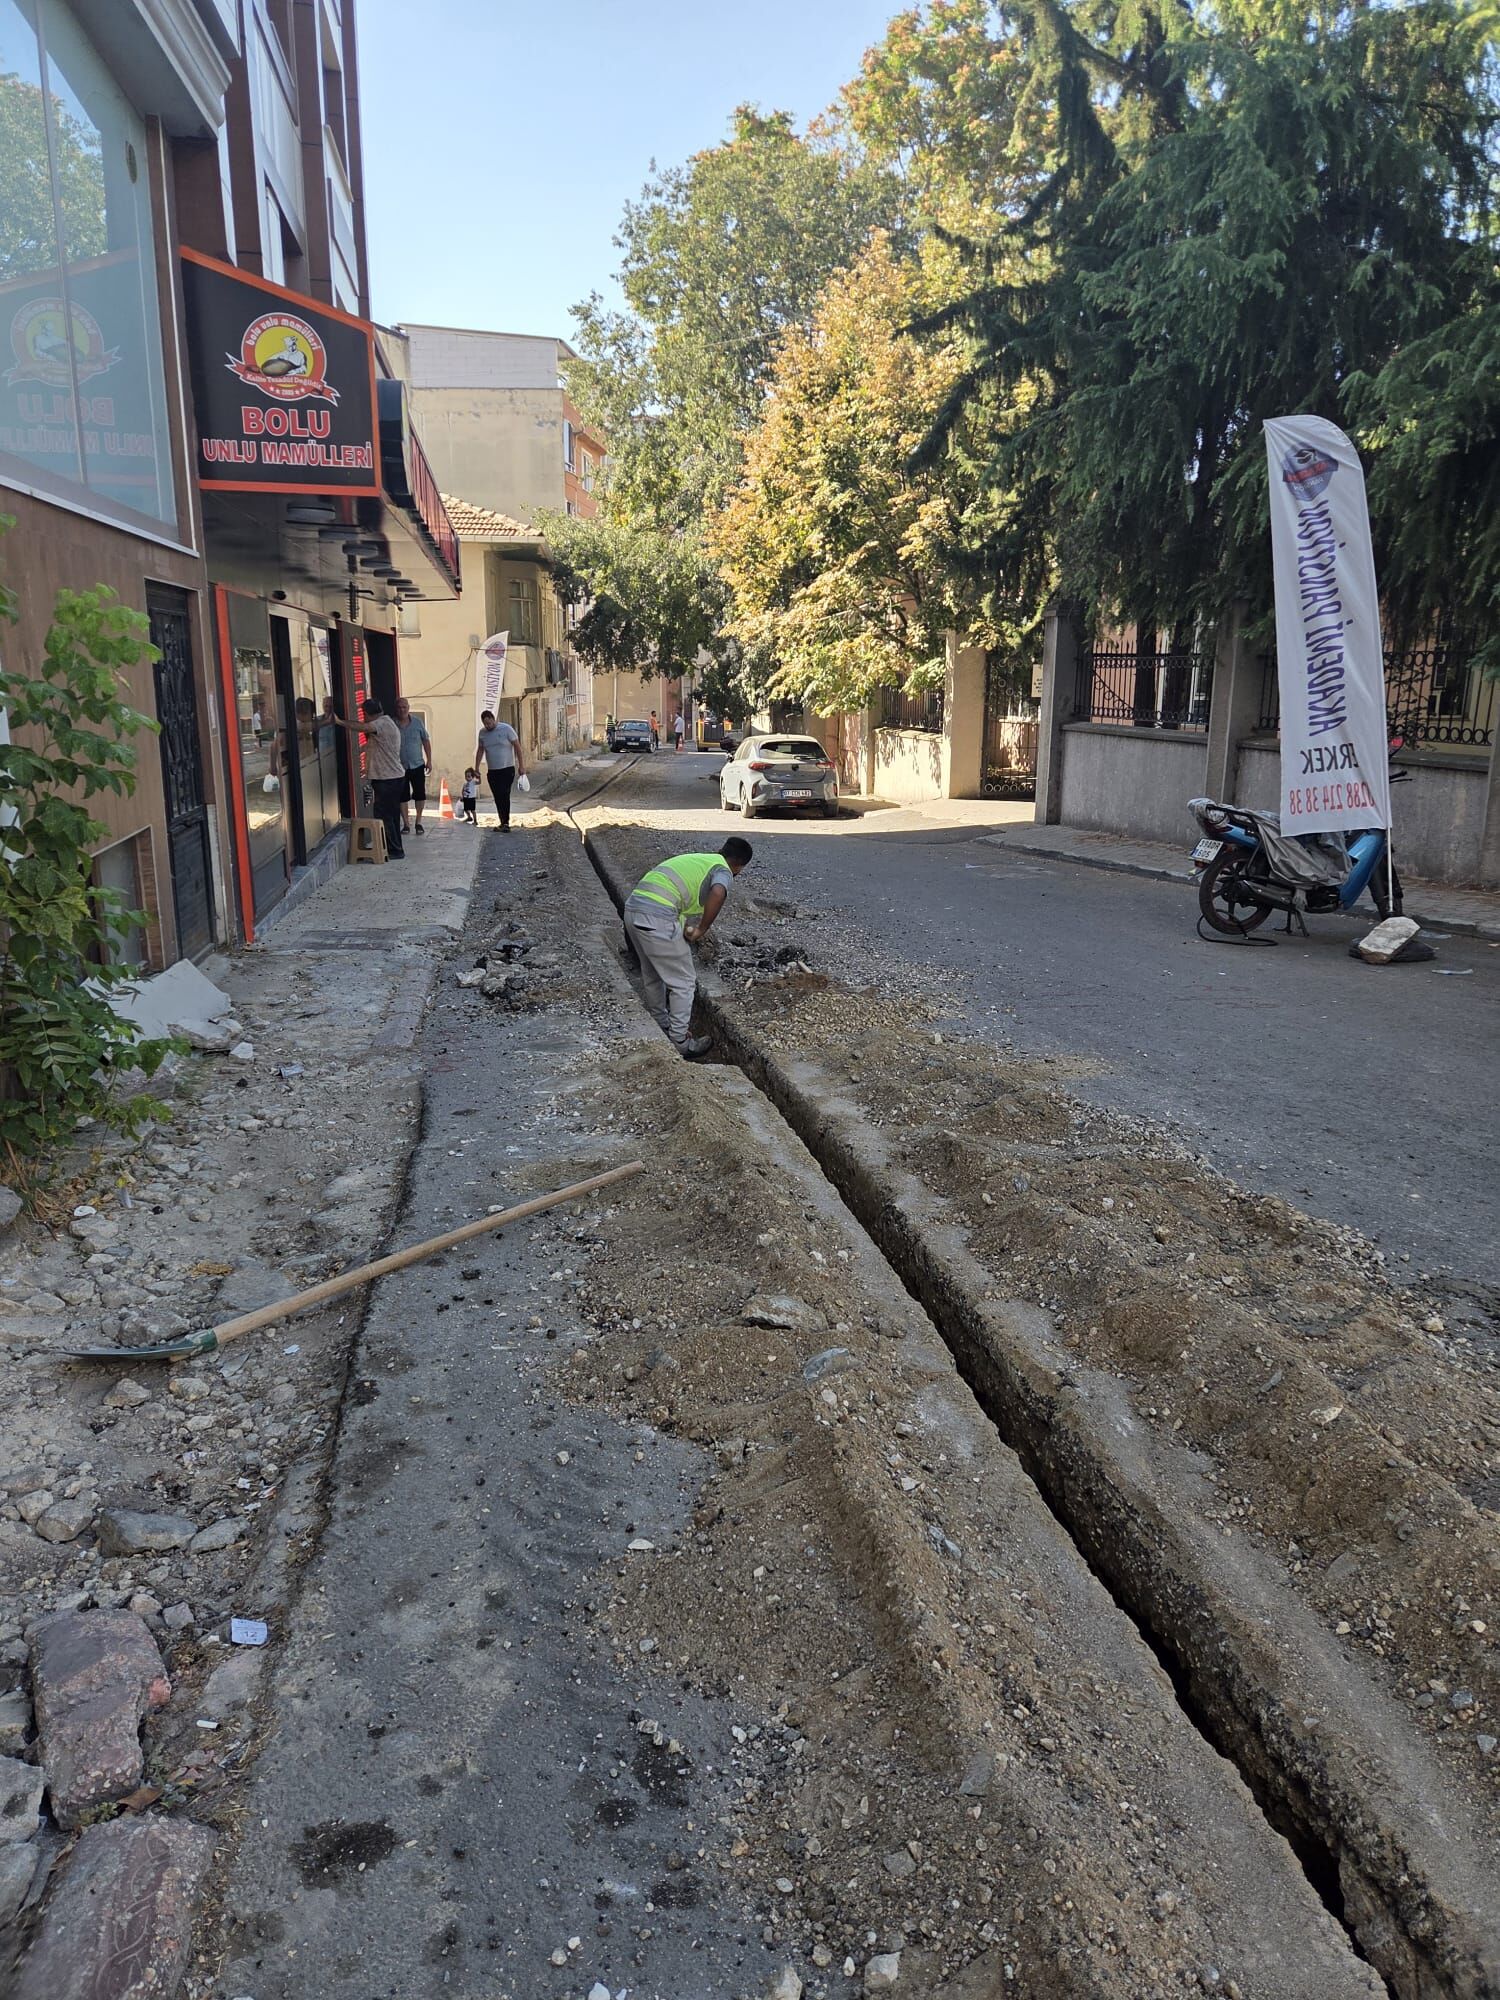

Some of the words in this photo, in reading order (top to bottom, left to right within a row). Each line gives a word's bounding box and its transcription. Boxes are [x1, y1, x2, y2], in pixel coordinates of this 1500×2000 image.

[246, 327, 262, 346] bolu
[241, 406, 331, 439] BOLU
[202, 438, 257, 463] UNLU
[261, 439, 374, 468] MAMÜLLERİ
[483, 661, 501, 698] PANSİYON
